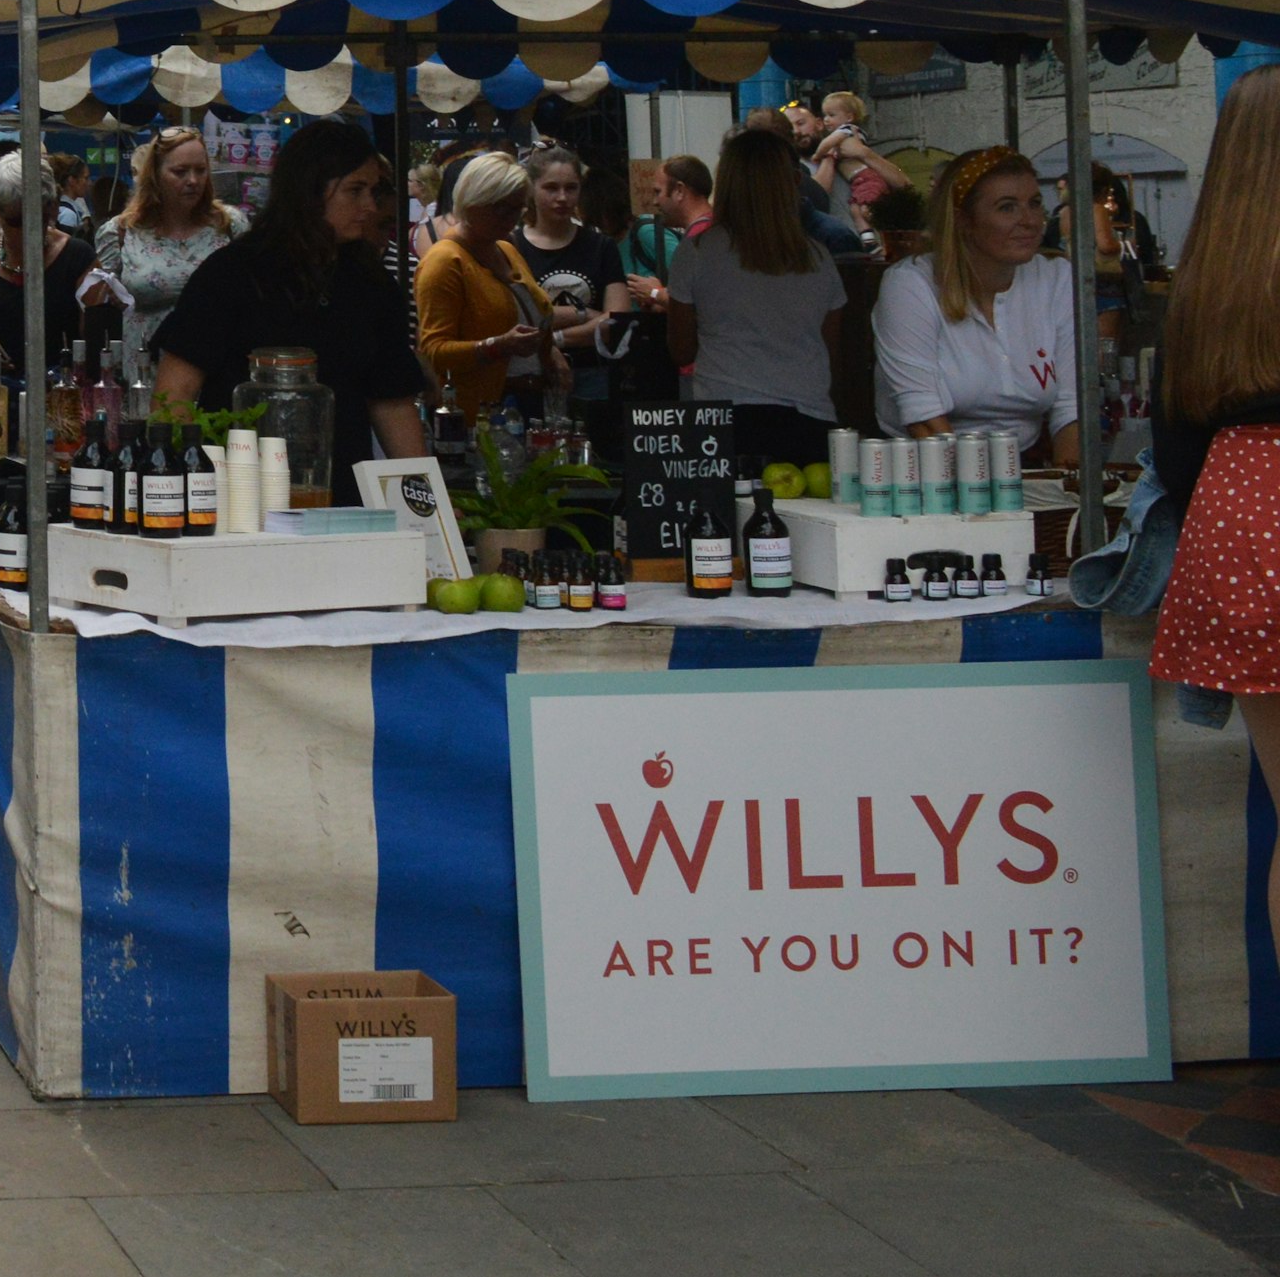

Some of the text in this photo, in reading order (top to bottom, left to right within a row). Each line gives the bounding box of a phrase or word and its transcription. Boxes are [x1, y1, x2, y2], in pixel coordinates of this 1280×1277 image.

[632, 408, 733, 426] HONEY APPLE
[633, 434, 683, 454] CIDER
[662, 458, 731, 479] VINEGAR
[873, 451, 883, 483] WILLYS
[403, 485, 436, 505] taste
[638, 482, 665, 507] £8
[595, 790, 1059, 896] WILLYS
[603, 926, 1084, 978] ARE YOU ON IT?
